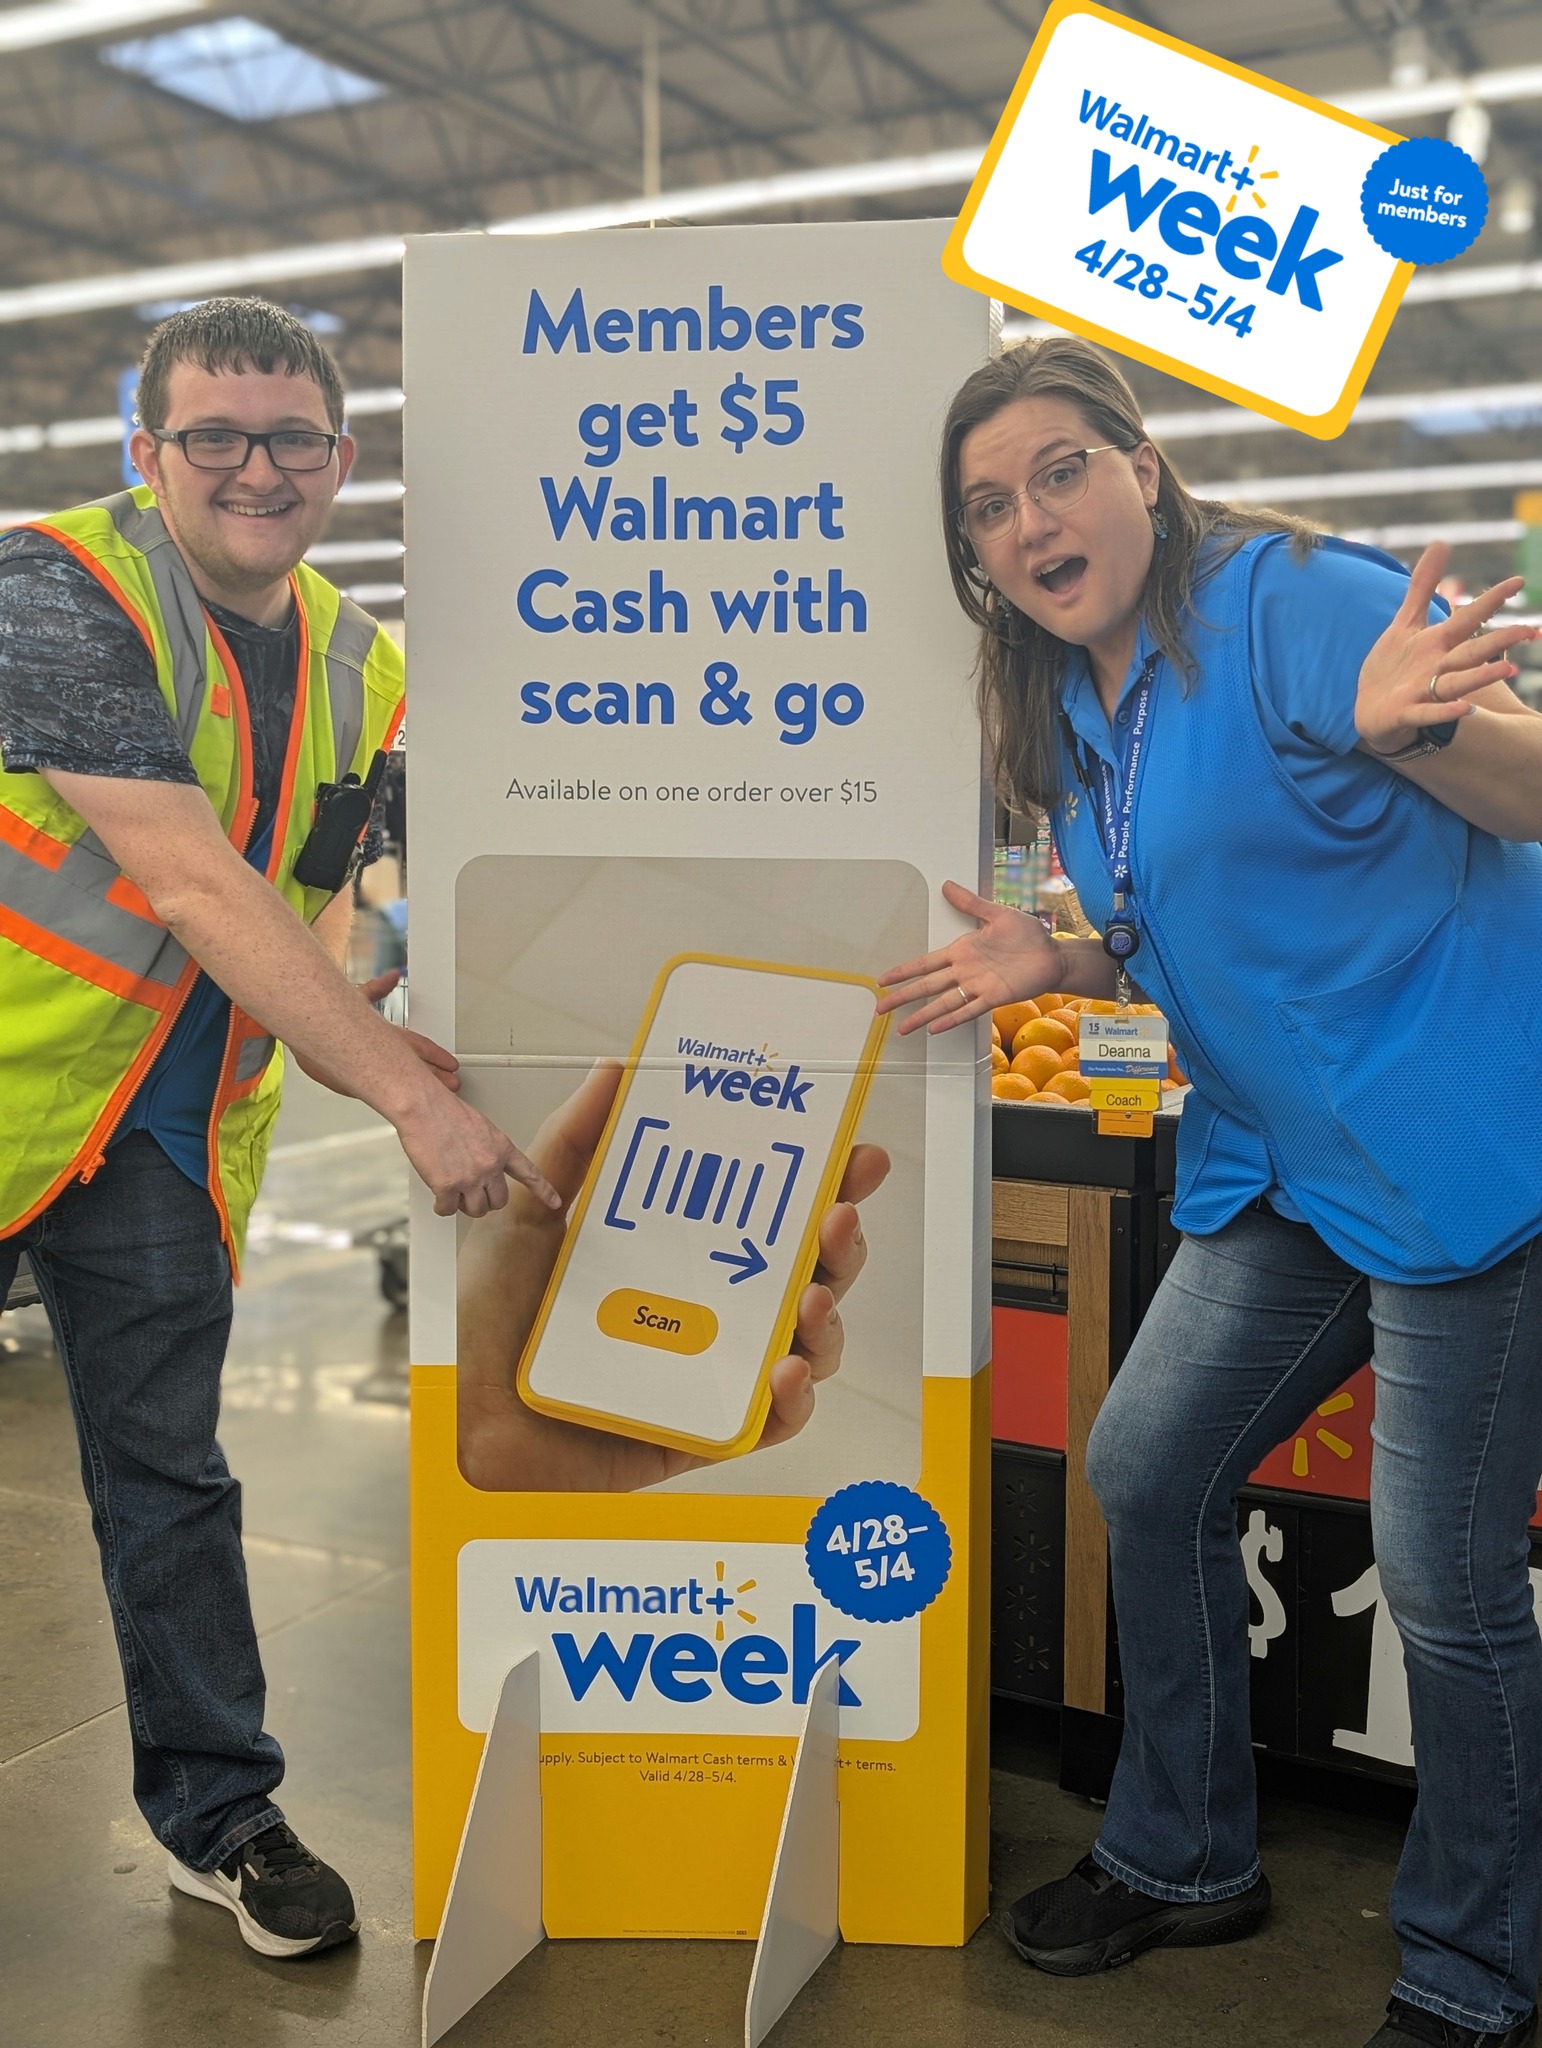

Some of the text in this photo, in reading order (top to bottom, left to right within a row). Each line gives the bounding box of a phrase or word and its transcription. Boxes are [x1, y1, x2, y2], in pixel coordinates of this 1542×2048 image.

[522, 285, 864, 354] Members
[578, 372, 805, 467] get $5
[540, 476, 844, 541] Walmart
[516, 568, 867, 633] Cash with
[520, 661, 864, 745] scan & go
[506, 778, 878, 805] Available on one order over $15
[1118, 689, 1148, 858] People Performance Purpose
[1088, 1022, 1138, 1036] 15 Walmart
[677, 1037, 767, 1067] Walmart+
[1098, 1043, 1151, 1058] Deanna
[1125, 1064, 1159, 1075] Difference
[684, 1064, 814, 1114] week
[1105, 1093, 1142, 1107] Coach
[633, 1305, 682, 1334] Scan
[856, 1552, 915, 1590] 5/4
[515, 1576, 734, 1615] Walmart+
[551, 1603, 862, 1707] week
[539, 1752, 575, 1767] upply.
[578, 1752, 625, 1767] Subject
[629, 1753, 642, 1764] to
[646, 1752, 699, 1765] Walmart
[702, 1753, 733, 1766] Cash
[737, 1754, 774, 1767] terms
[777, 1755, 788, 1767] &
[856, 1759, 897, 1772] terms.
[639, 1770, 670, 1782] Valid
